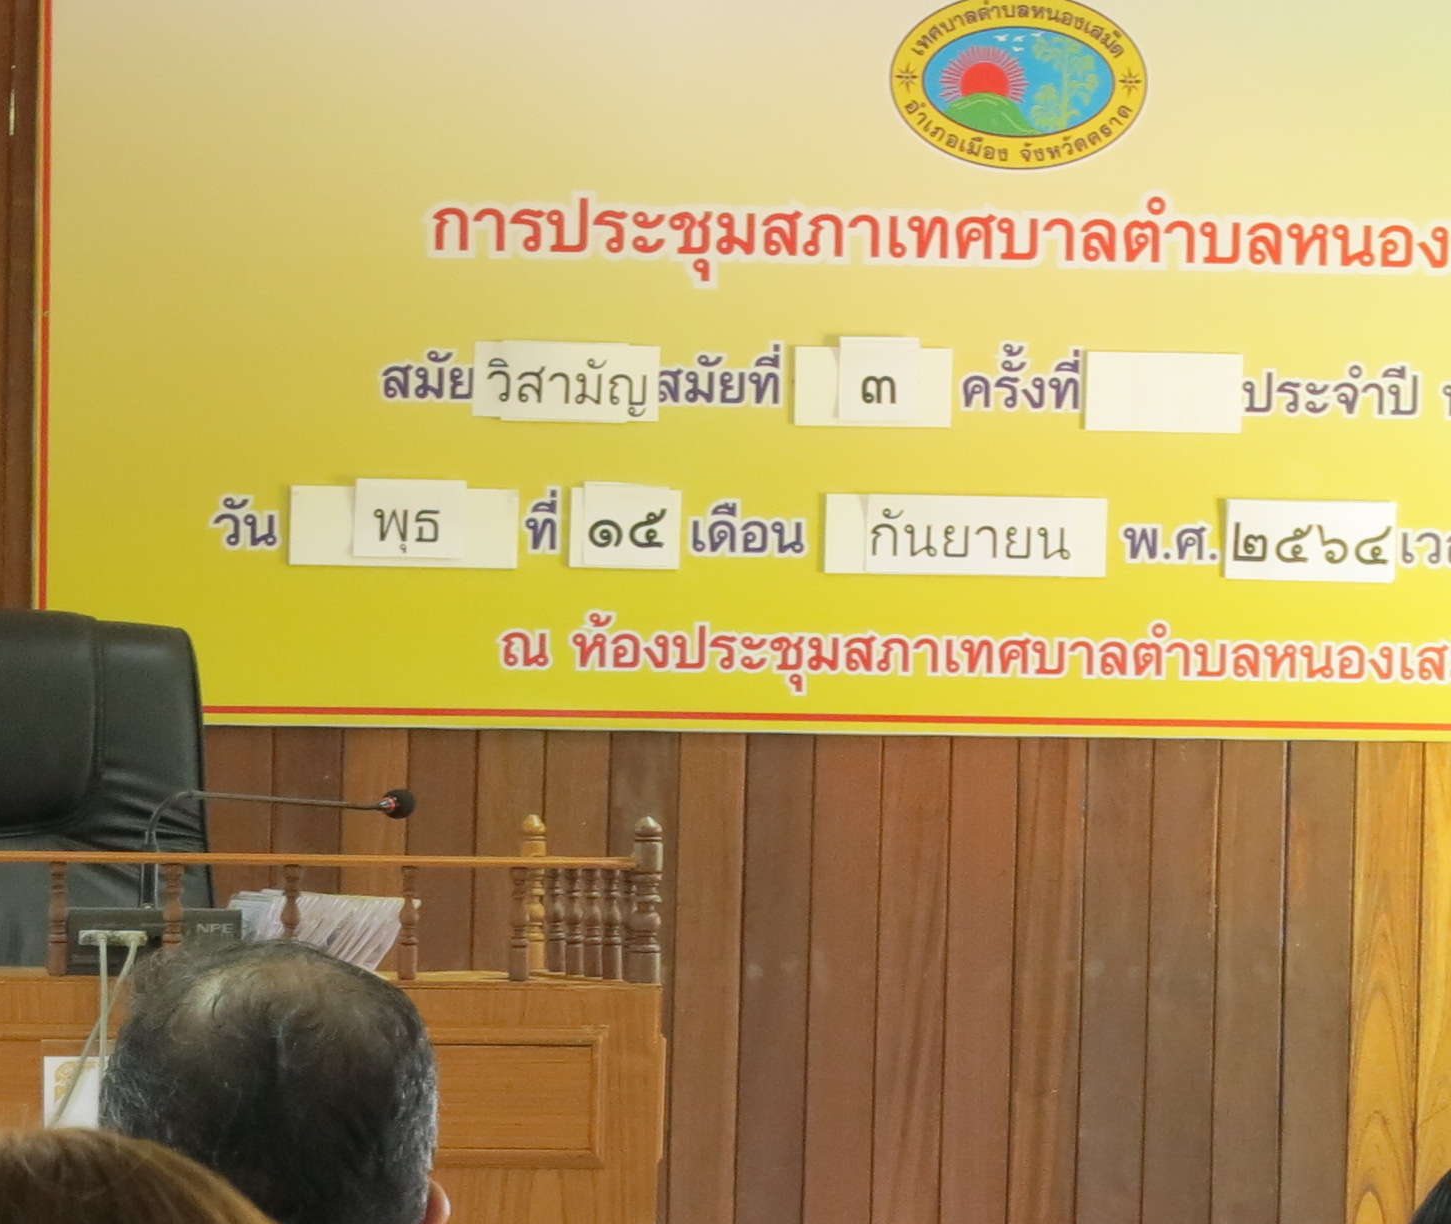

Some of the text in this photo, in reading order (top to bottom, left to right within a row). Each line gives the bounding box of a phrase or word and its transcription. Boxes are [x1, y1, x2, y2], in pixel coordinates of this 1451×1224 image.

[905, 100, 1133, 162] อำเภอเมือง จังหวัดตราด
[432, 196, 1448, 282] การประชุมสภาเทศบาลตำบลหนอง
[382, 350, 474, 400] สมัย
[486, 357, 648, 418] วิสามัญ
[657, 343, 781, 404] สมัยที่
[860, 372, 897, 404] ๓
[962, 343, 1081, 409] ครั้งที่
[1243, 365, 1419, 416] ประจำปี
[213, 498, 277, 547] วัน
[373, 506, 441, 554] พุธ
[525, 490, 558, 551] ที่
[588, 507, 667, 549] ๑๕
[691, 501, 805, 554] เดือน
[870, 508, 1071, 560] กันยายน
[1124, 521, 1218, 563] พ.ศ.
[1231, 521, 1392, 566] ๒๕๖๔
[501, 612, 1451, 693] ณ ห้องประชุมสภาเทศบาลตำบลหนองเส
[197, 923, 234, 934] NPE
